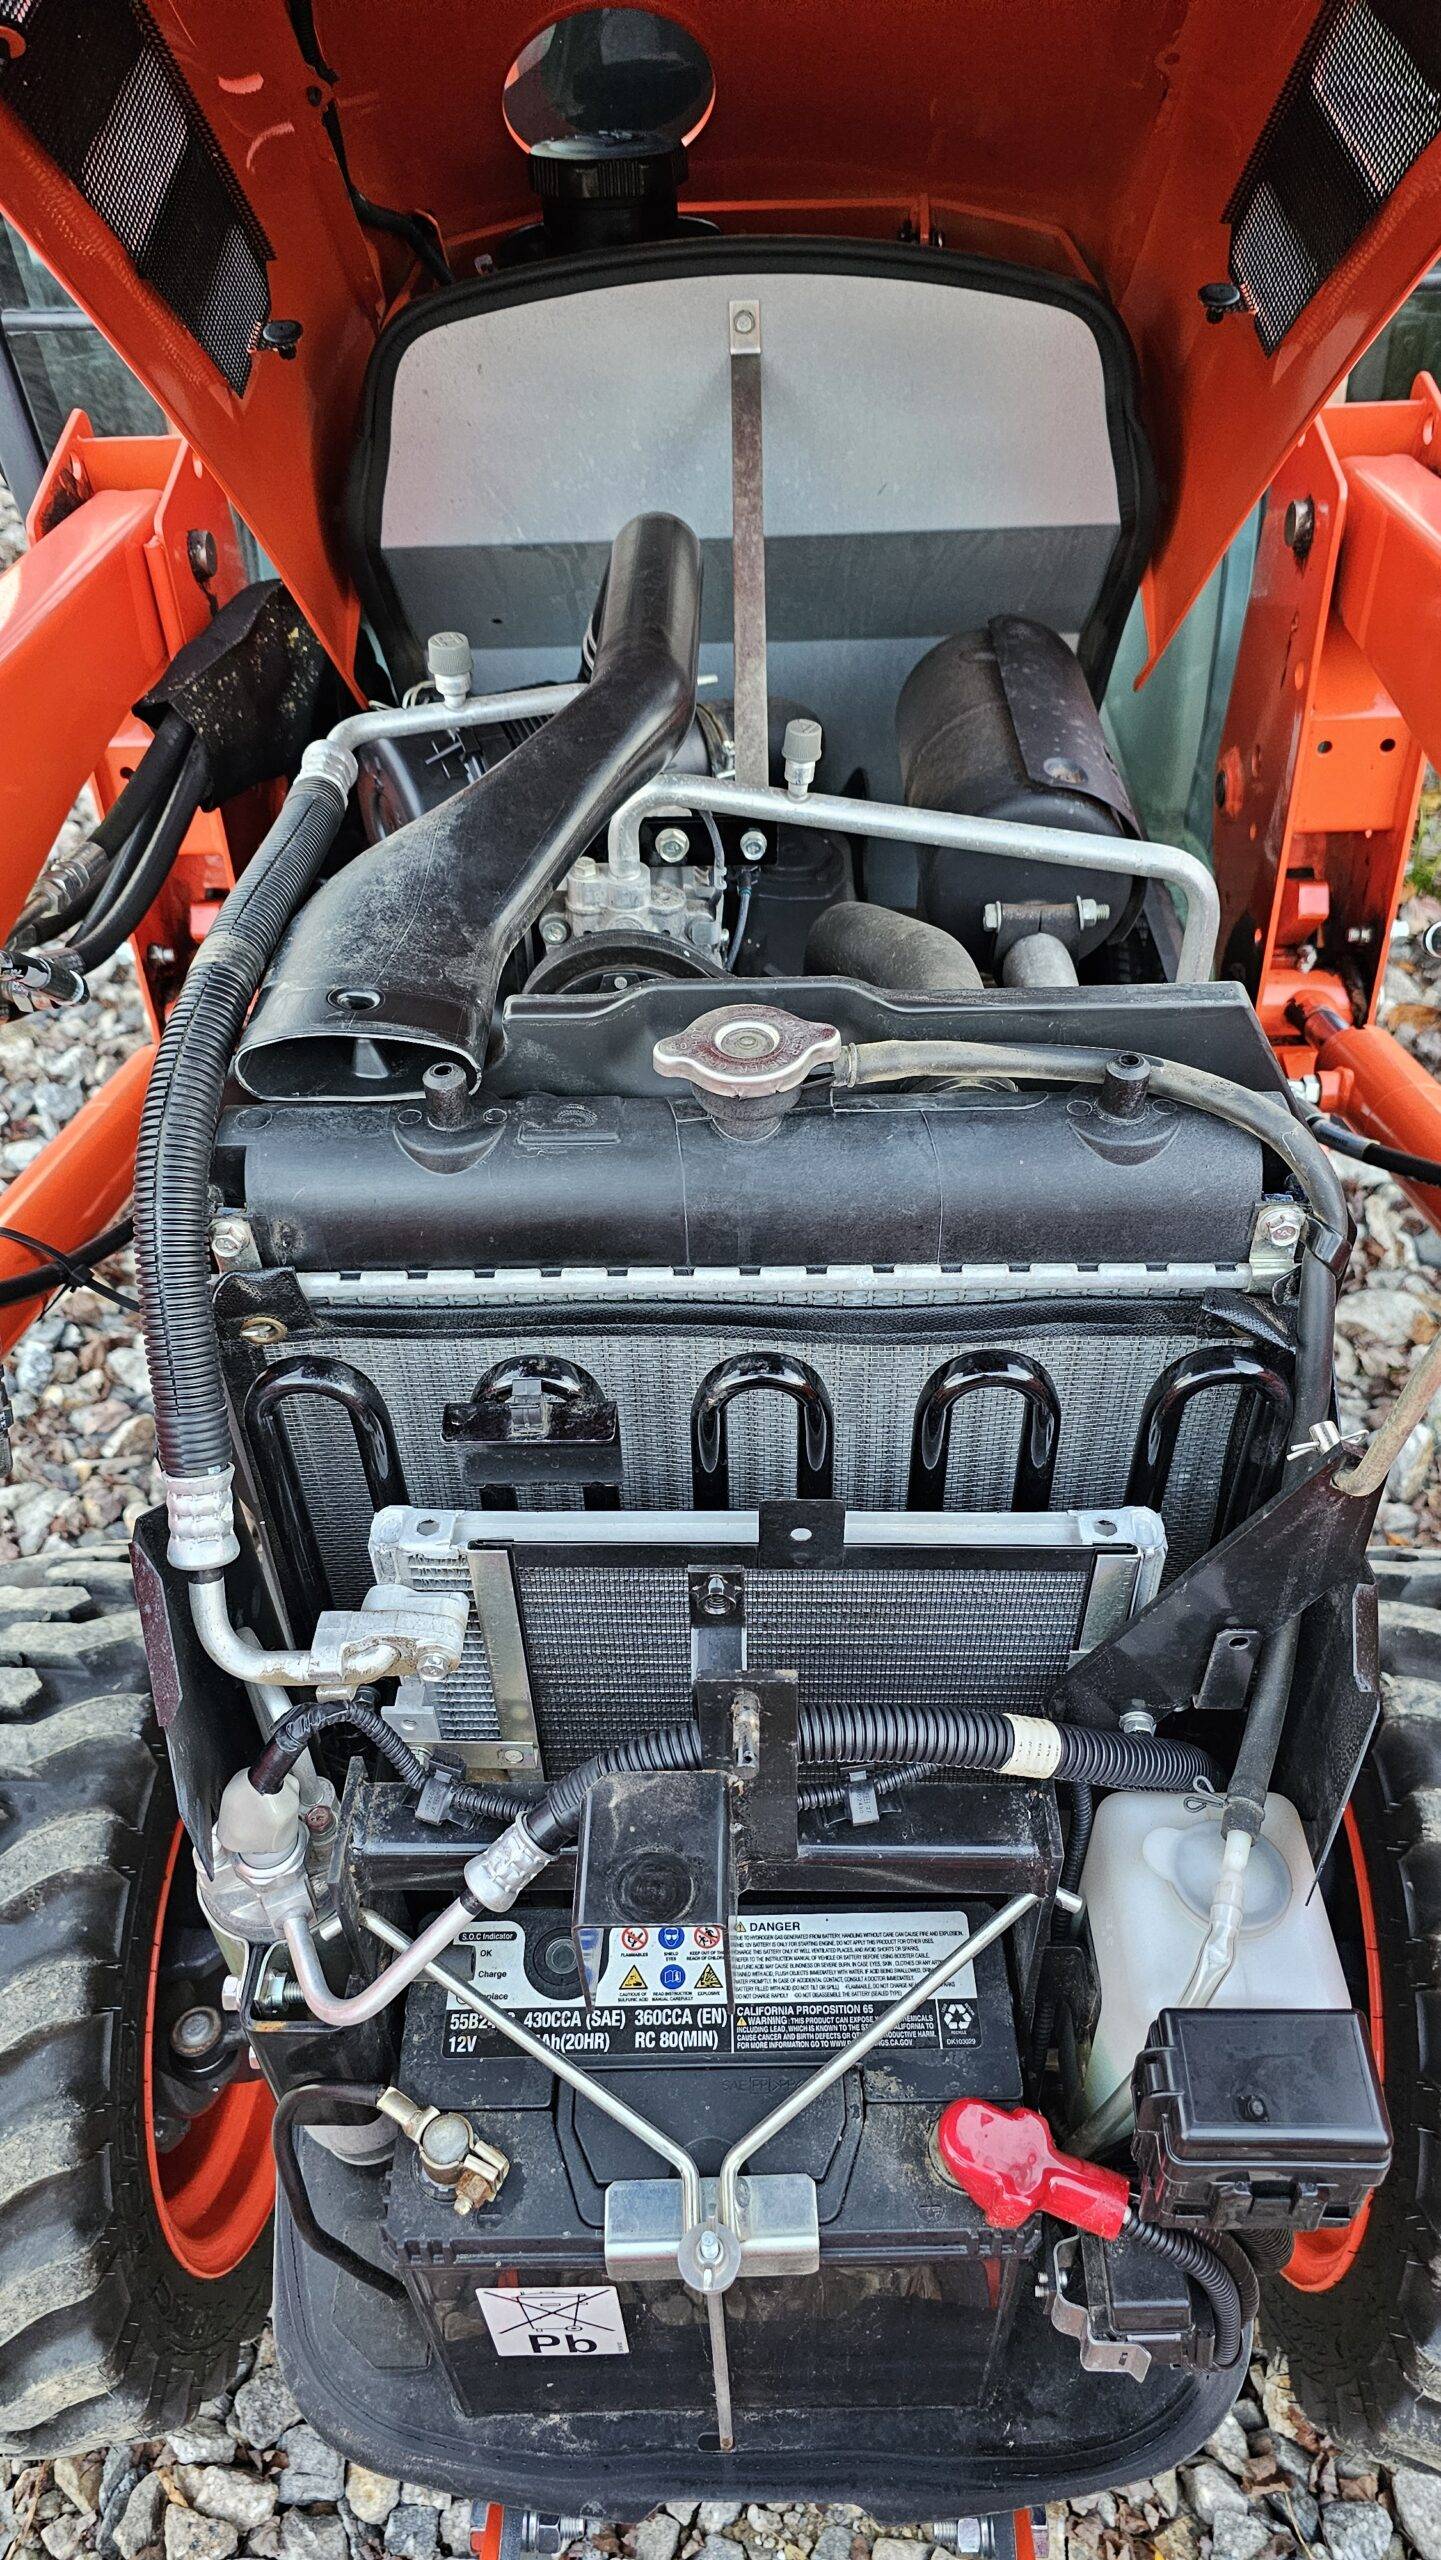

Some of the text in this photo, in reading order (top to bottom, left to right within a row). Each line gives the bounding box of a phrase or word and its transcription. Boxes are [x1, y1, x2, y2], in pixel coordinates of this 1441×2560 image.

[750, 1922, 801, 1932] DANGER
[461, 1932, 514, 1941] S.O.C Indicator
[478, 1970, 507, 1980] Charge
[736, 2004, 874, 2016] CALIFORNIA PROPOSITION 65
[524, 2010, 582, 2028] 430CCA
[586, 2010, 626, 2030] (SAE)
[634, 2008, 693, 2026] 360CCA
[697, 2007, 728, 2028] (EN)
[791, 2017, 805, 2025] THIS
[805, 2016, 835, 2025] PRODUCT
[835, 2016, 849, 2024] CAN
[850, 2016, 874, 2024] EXPOSE
[902, 2014, 935, 2022] EMICALS
[736, 2026, 769, 2034] INCLUDING
[816, 2024, 839, 2032] KNOWN
[839, 2024, 847, 2032] TO
[894, 2022, 925, 2031] ALIFORNIA
[926, 2022, 935, 2030] TO
[757, 2033, 782, 2041] CANCER
[783, 2033, 796, 2041] AND
[796, 2032, 815, 2040] BIRTH
[815, 2032, 842, 2040] DEFECTS
[842, 2032, 850, 2040] OR
[885, 2031, 917, 2039] ODUCTIVE
[448, 2030, 719, 2054] 12V Ah(20HR) RC 80(MIN)
[736, 2042, 750, 2050] FOR
[750, 2041, 768, 2049] MORE
[769, 2041, 810, 2049] INFORMATION
[810, 2040, 820, 2048] GO
[821, 2040, 830, 2048] TO
[528, 2334, 597, 2353] Pb
